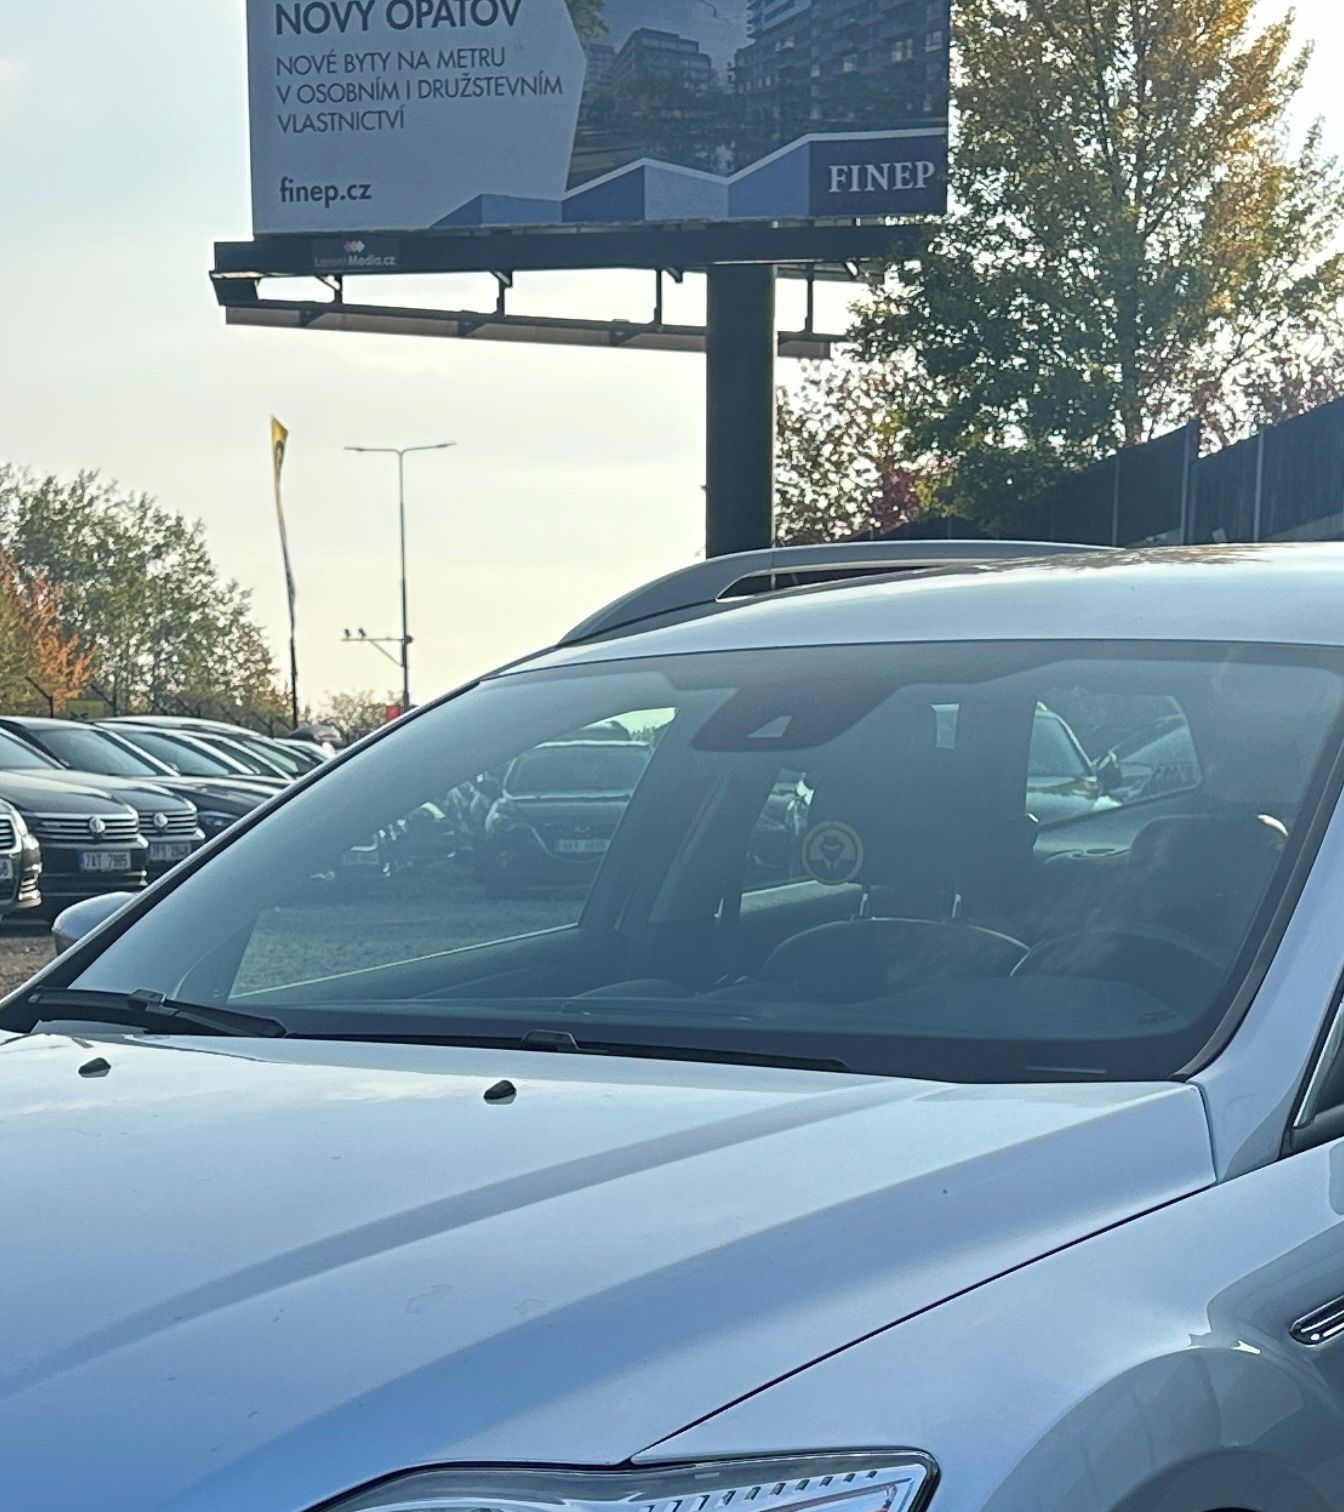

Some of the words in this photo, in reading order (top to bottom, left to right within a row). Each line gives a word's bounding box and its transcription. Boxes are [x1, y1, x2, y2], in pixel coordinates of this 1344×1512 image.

[276, 50, 337, 76] NOVÉ
[344, 52, 392, 74] BYTY
[397, 50, 431, 71] NA
[436, 46, 506, 69] METRU
[277, 84, 291, 104] V
[297, 76, 400, 104] OSOBNÍM
[417, 70, 563, 99] DRUŽSTEVNÍM
[277, 105, 405, 133] VLASTNICTVÍ
[280, 176, 372, 209] finep.cz
[828, 160, 936, 193] FINEP
